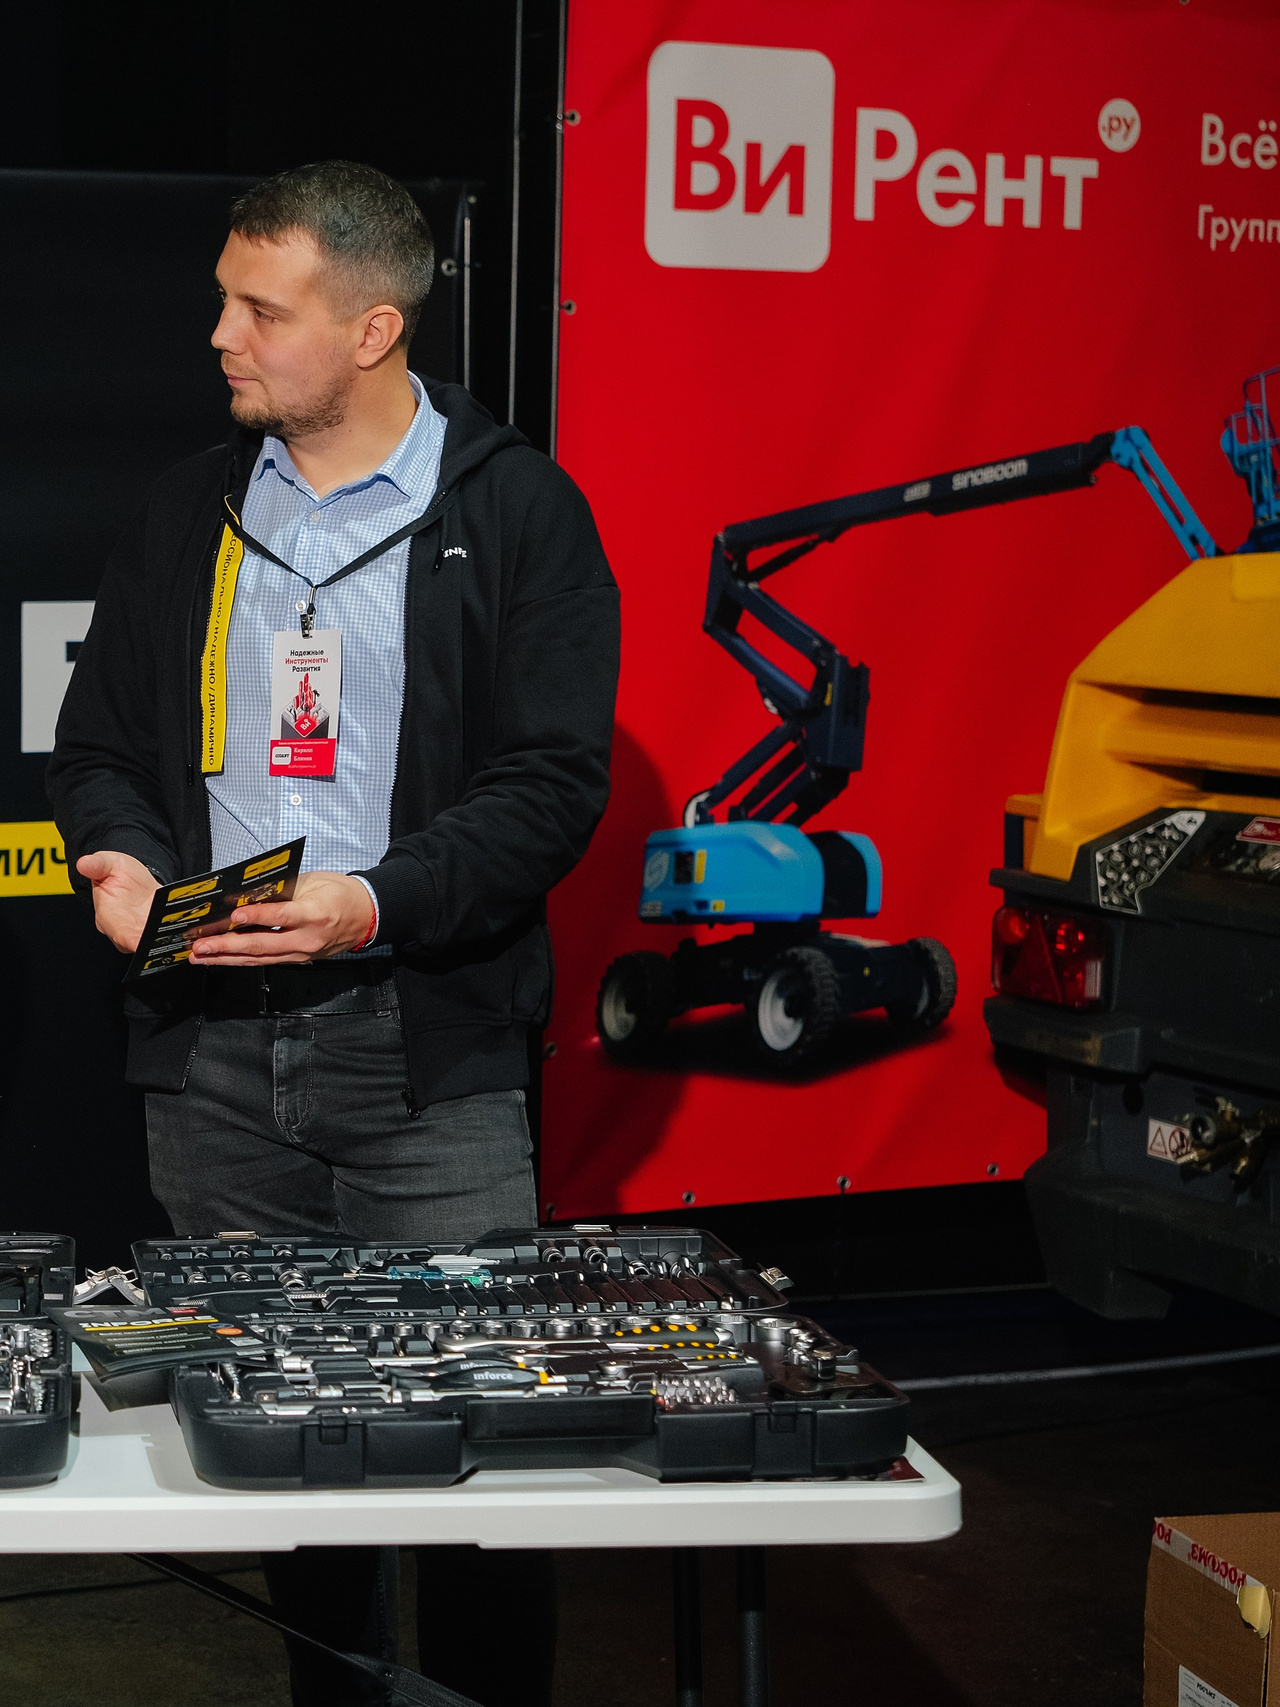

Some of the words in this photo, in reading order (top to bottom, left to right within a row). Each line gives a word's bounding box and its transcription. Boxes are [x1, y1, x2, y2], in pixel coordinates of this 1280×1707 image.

[1201, 112, 1279, 170] Всё
[673, 98, 807, 217] Ви
[854, 107, 1099, 231] Рент
[209, 626, 219, 685] НАДЕЖНО
[285, 657, 329, 666] Инструменты
[290, 649, 324, 657] Надежные
[292, 665, 321, 673] Развития
[208, 693, 216, 766] ДИНАМИЧНО
[78, 1315, 216, 1329] INFORCE
